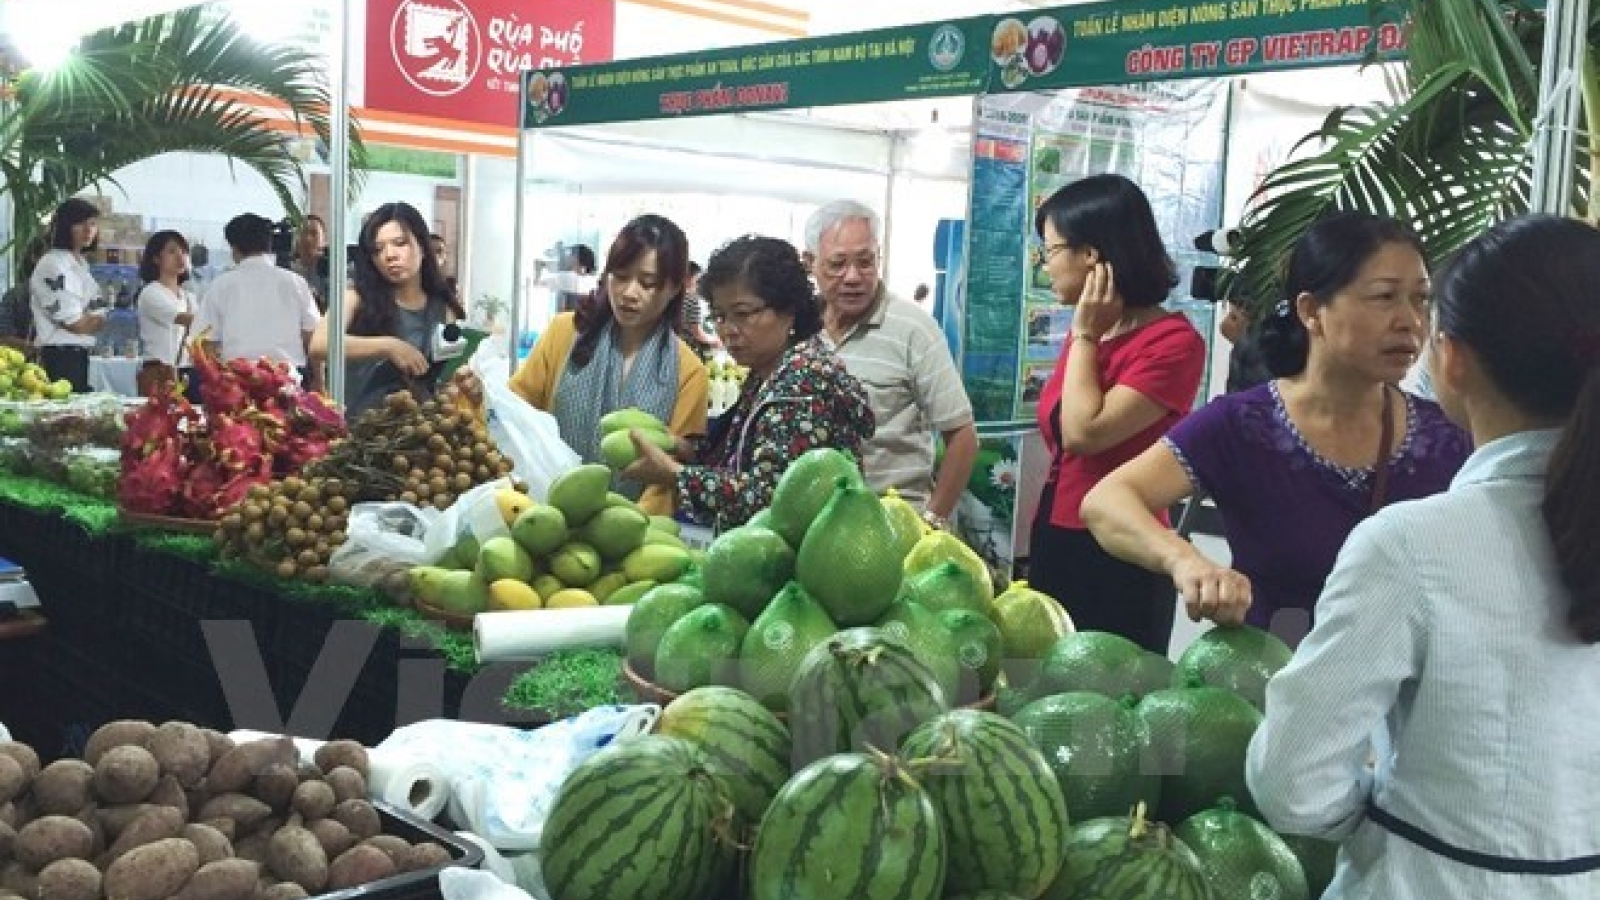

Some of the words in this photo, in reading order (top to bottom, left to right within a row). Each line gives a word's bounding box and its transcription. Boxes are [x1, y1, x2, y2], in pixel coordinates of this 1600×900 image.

[1158, 6, 1187, 30] DIỆN
[1125, 43, 1185, 75] CÔNG
[1190, 41, 1222, 70] TY
[1224, 38, 1259, 66] CP
[1263, 26, 1373, 65] VIETRAP
